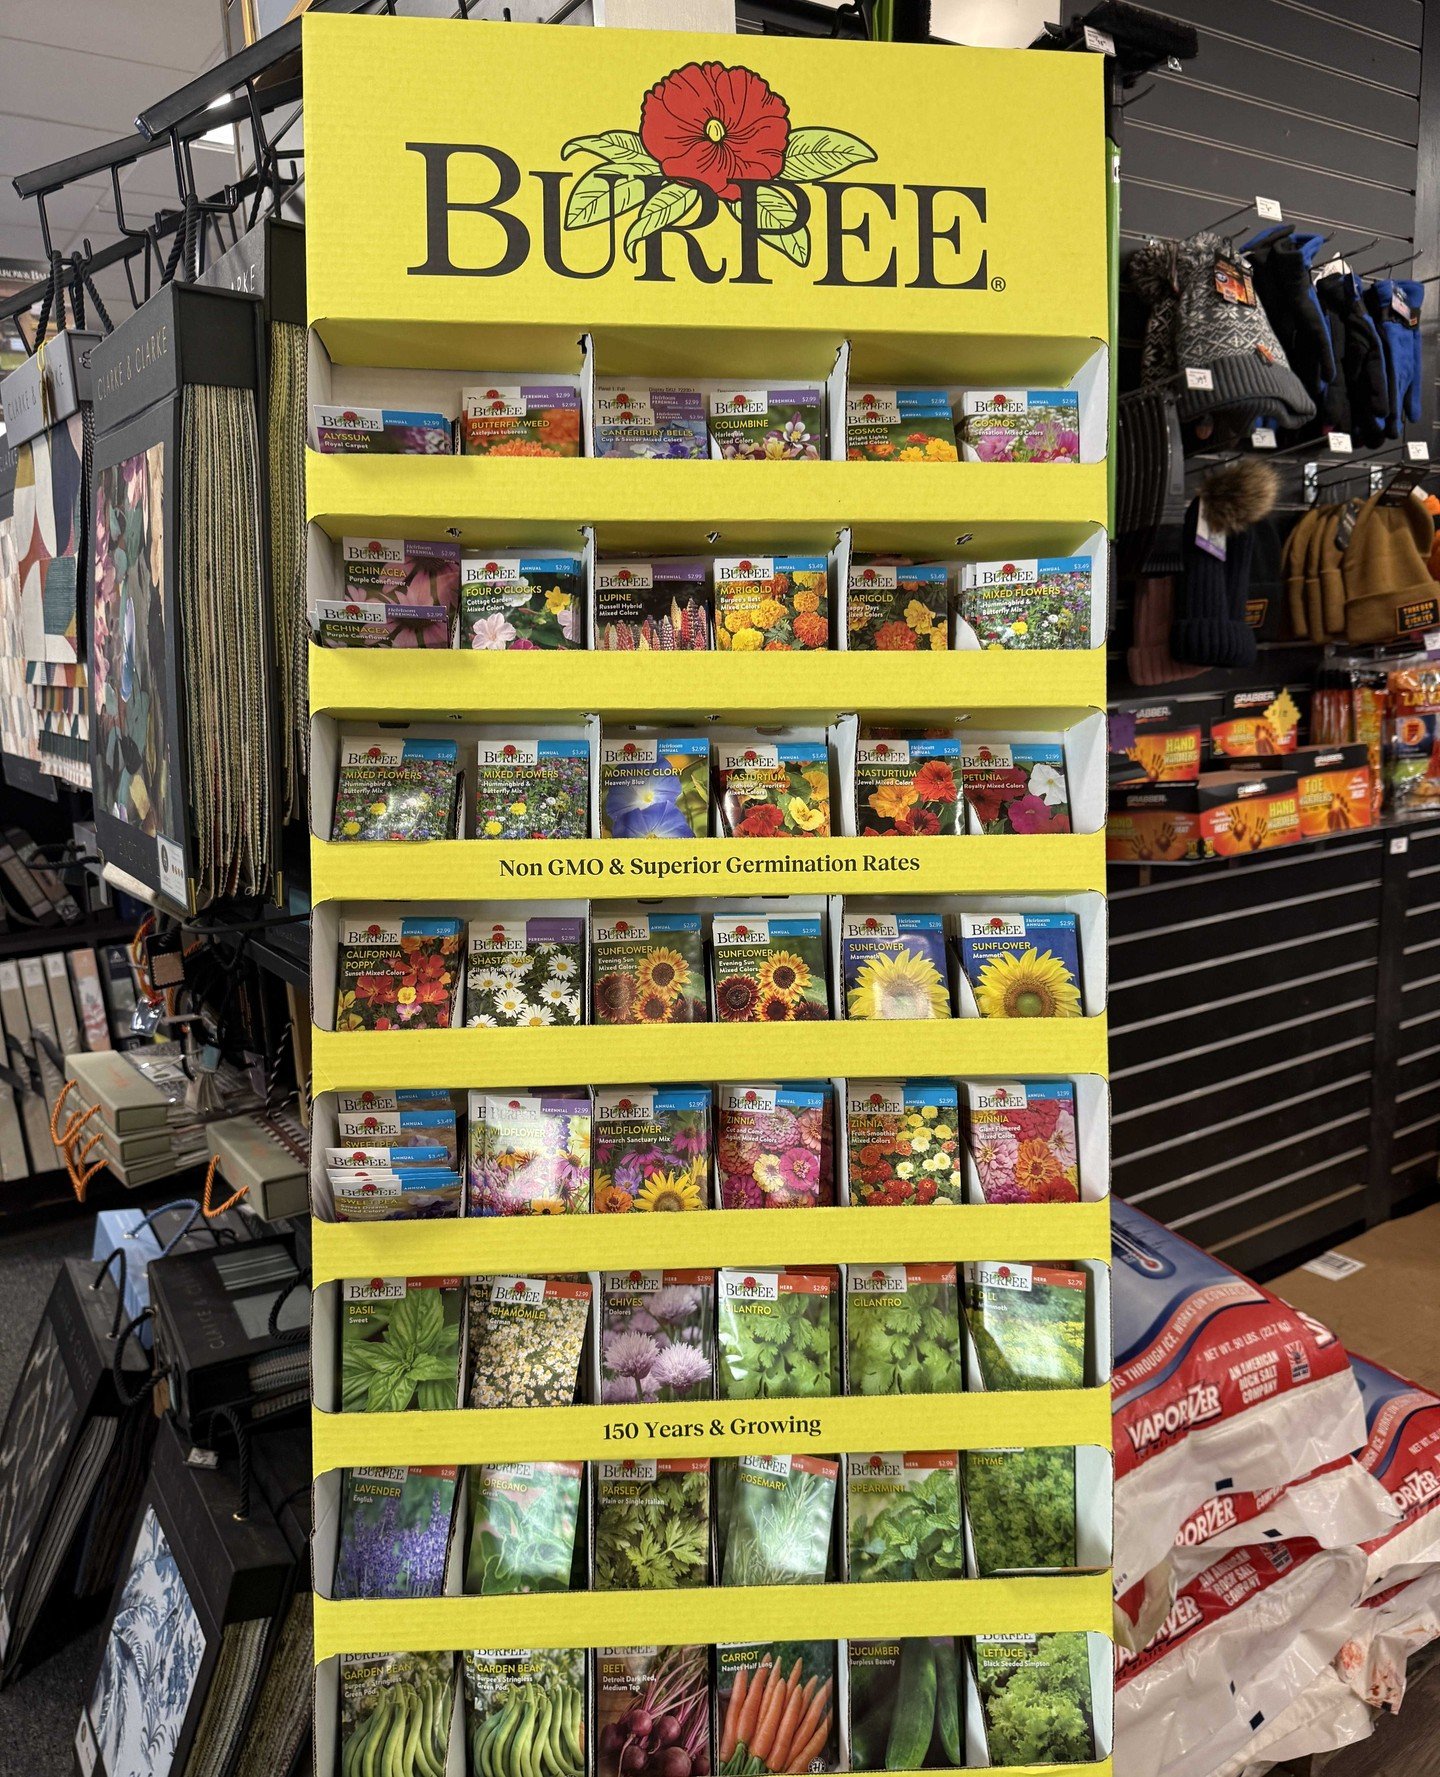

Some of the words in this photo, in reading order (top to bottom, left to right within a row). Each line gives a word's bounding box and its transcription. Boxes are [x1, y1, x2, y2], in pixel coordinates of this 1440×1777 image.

[404, 141, 991, 293] BURPEE
[974, 401, 1024, 412] BURPEE
[473, 406, 523, 417] BURPEE
[321, 415, 380, 430] BURPEE
[471, 420, 520, 429] BUTTERFLY
[715, 419, 768, 429] COLUMBINE
[974, 419, 1015, 427] COSMOS
[848, 427, 888, 435] COSMOS
[323, 433, 371, 442] ALYSSUM
[347, 442, 369, 450] Carpet
[349, 565, 407, 577] ECHINACEA
[467, 569, 517, 581] BURPEE
[720, 567, 770, 579] BURPEE
[349, 575, 370, 584] Purple
[371, 578, 407, 586] Coneflower
[466, 587, 492, 596] FOUR
[494, 585, 542, 595] O'CLOCKS
[720, 585, 772, 595] MARIGOLD
[983, 589, 1013, 600] MIXED
[1015, 586, 1061, 597] FLOWERS
[466, 598, 490, 606] Cottage
[599, 593, 632, 602] LUPINE
[622, 603, 643, 611] Hybrid
[326, 624, 389, 635] ECHINACEA
[1166, 736, 1196, 750] HAND
[605, 750, 654, 762] BURPEE
[962, 756, 1011, 767] BURPEE
[483, 770, 514, 779] MIXED
[516, 770, 559, 779] FLOWERS
[604, 768, 650, 778] MORNING
[652, 767, 683, 776] GLORY
[726, 773, 786, 781] NASTURTIUM
[857, 769, 917, 778] NASTURTIUM
[963, 774, 1003, 782] PETUNIA
[964, 783, 986, 791] Royalty
[1269, 800, 1296, 815] HAND
[499, 859, 543, 877] Non
[548, 859, 604, 876] GMO
[610, 859, 626, 875] &
[631, 856, 721, 879] Superior
[726, 854, 857, 875] Germination
[863, 854, 921, 872] Rates
[597, 928, 647, 941] BURPEE
[849, 942, 904, 951] SUNFLOWER
[972, 941, 1031, 950] SUNFLOWER
[346, 950, 402, 959] CALIFORNIA
[597, 946, 653, 955] SUNFLOWER
[718, 949, 773, 958] SUNFLOWER
[345, 960, 375, 969] POPPY
[472, 956, 506, 965] SHASTA
[508, 956, 536, 965] DAISY
[727, 1116, 755, 1125] ZINNIA
[851, 1119, 884, 1128] ZINNIA
[979, 1115, 1009, 1123] ZINNIA
[345, 1123, 398, 1136] BURPEE
[490, 1128, 546, 1137] WILDFLOWER
[599, 1125, 662, 1135] WILDFLOWER
[345, 1140, 375, 1148] SWEET
[378, 1140, 399, 1148] PEA
[627, 1136, 657, 1144] Sanctuary
[611, 1277, 659, 1290] BURPEE
[349, 1285, 403, 1298] BURPEE
[978, 1292, 997, 1301] DILL
[609, 1297, 643, 1306] CHIVES
[853, 1298, 902, 1307] CILANTRO
[349, 1306, 376, 1315] BASIL
[492, 1307, 546, 1320] CHAMOMILE
[724, 1304, 771, 1315] CILANTRO
[489, 1317, 511, 1325] German
[1123, 1349, 1165, 1380] THROUGH
[1127, 1379, 1222, 1452] VAPORIZER
[604, 1422, 639, 1440] 150
[644, 1421, 704, 1438] Years
[709, 1419, 725, 1436] &
[730, 1415, 822, 1437] Growing
[972, 1457, 1003, 1465] THYME
[851, 1464, 901, 1476] BURPEE
[484, 1479, 527, 1492] OREGANO
[740, 1473, 787, 1491] ROSEMARY
[354, 1484, 401, 1497] LAVENDER
[602, 1486, 641, 1495] PARSLEY
[851, 1484, 905, 1493] SPEARMINT
[353, 1495, 373, 1503] English
[625, 1498, 644, 1506] Single
[1174, 1497, 1237, 1546] PORIZER
[849, 1646, 900, 1656] CUCUMBER
[983, 1648, 1023, 1658] LETTUCE
[721, 1651, 759, 1663] CARROT
[721, 1663, 743, 1672] Nantes
[744, 1662, 757, 1670] Half
[758, 1661, 772, 1670] Long
[875, 1658, 896, 1667] Beauty
[1024, 1660, 1050, 1668] Simpson
[344, 1667, 384, 1680] GARDEN
[386, 1663, 412, 1673] BEAN
[477, 1664, 516, 1673] GARDEN
[517, 1664, 543, 1673] BEAN
[603, 1664, 625, 1673] BEET
[626, 1675, 641, 1683] Dark
[642, 1674, 657, 1683] Red,
[629, 1683, 641, 1693] Top
